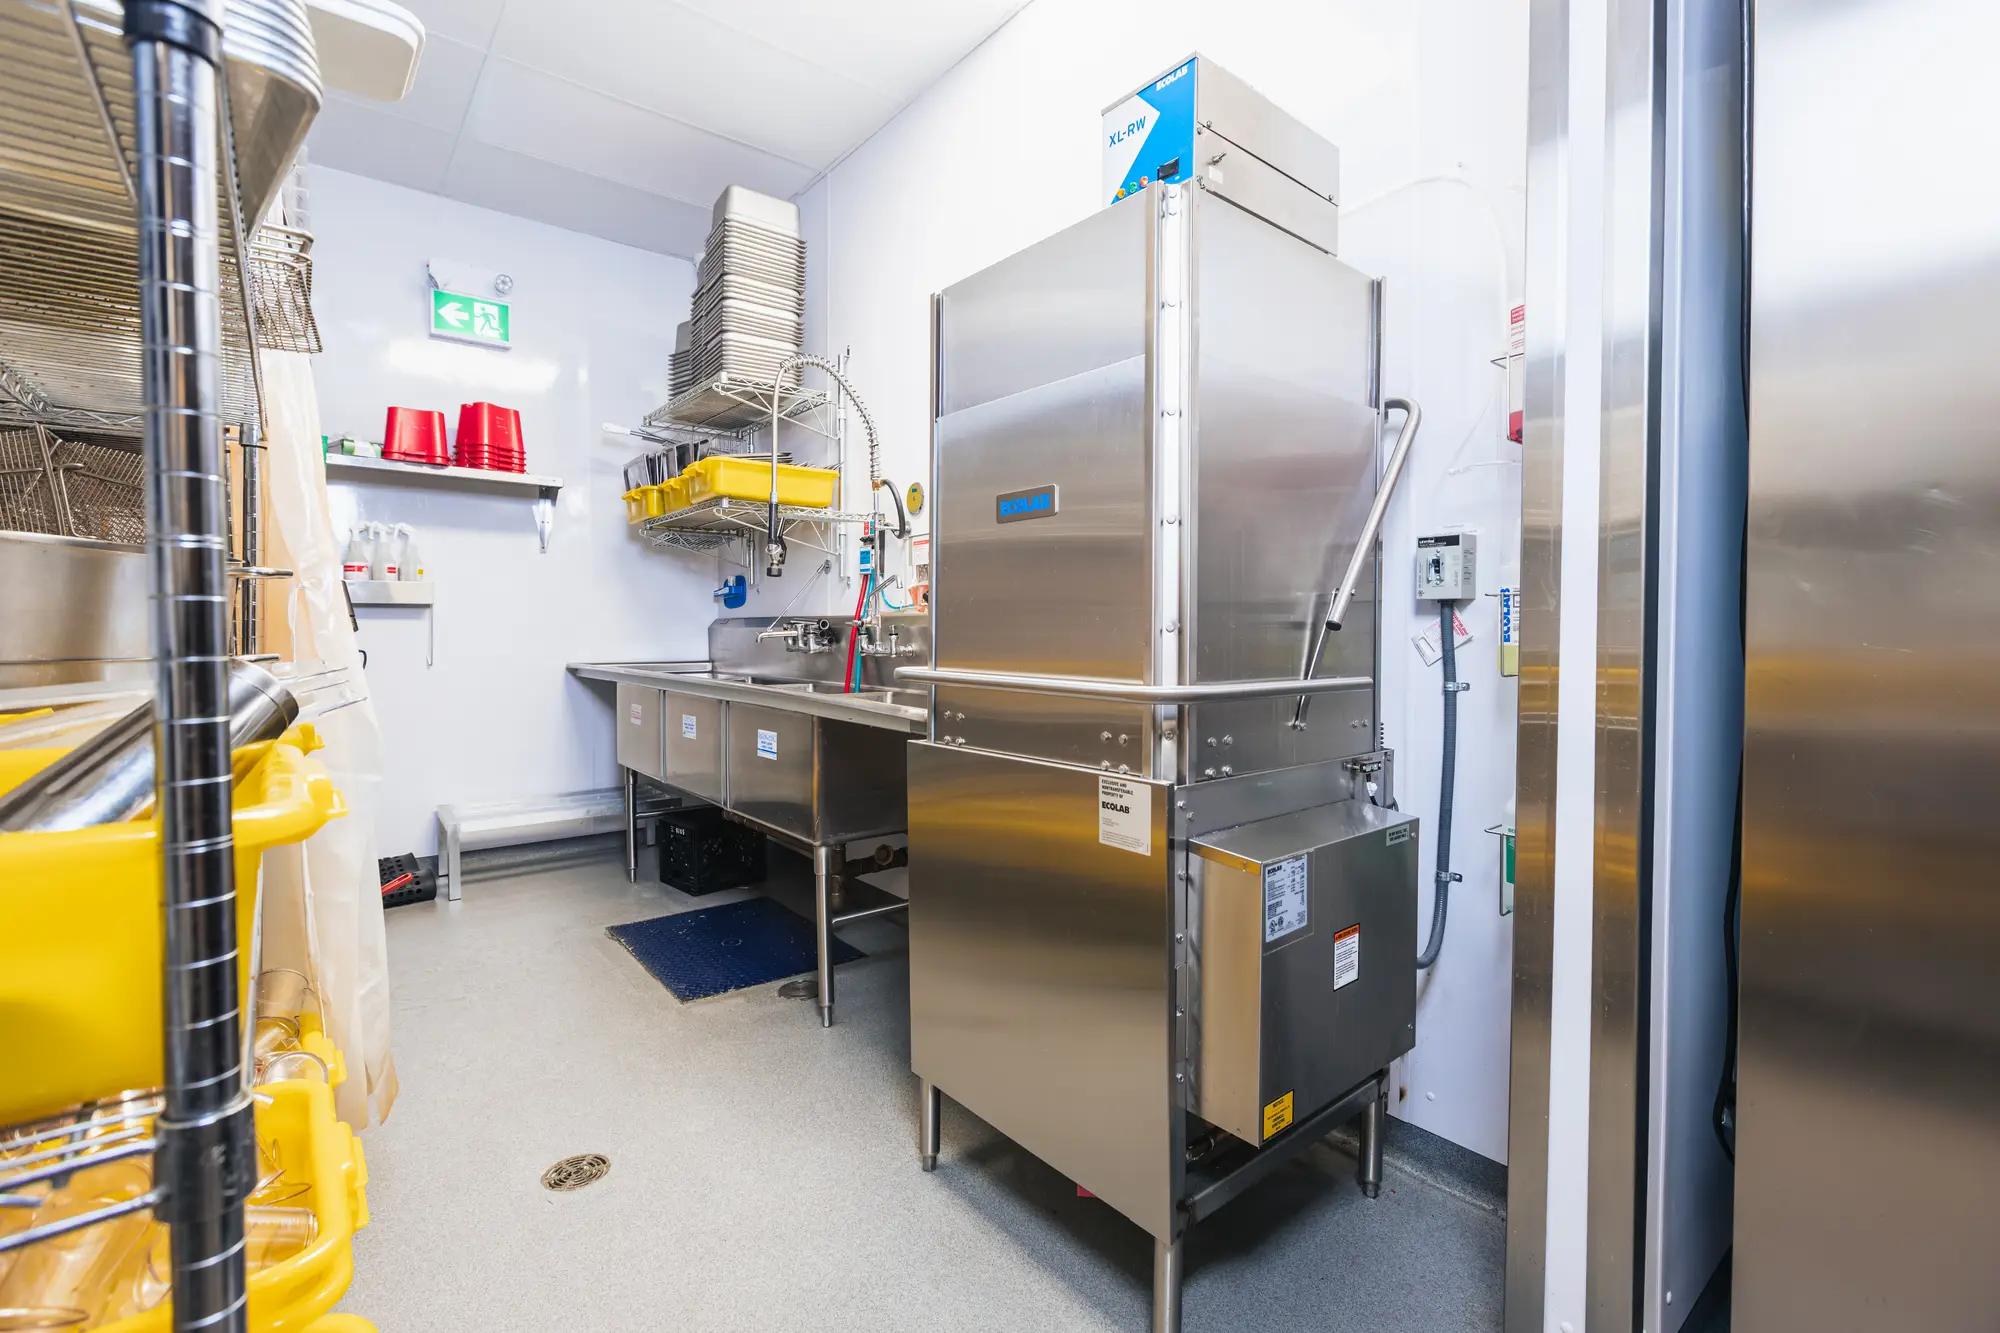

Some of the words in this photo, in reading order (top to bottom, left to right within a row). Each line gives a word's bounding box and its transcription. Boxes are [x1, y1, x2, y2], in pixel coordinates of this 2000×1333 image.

[1156, 65, 1188, 91] ECOLAB
[1109, 116, 1146, 148] XL-RW
[1000, 493, 1050, 516] ECOLAB
[1500, 588, 1510, 642] ECOLAB
[1102, 785, 1133, 795] NONTRANSFERABLE
[1102, 790, 1119, 798] PROPERTY
[1102, 801, 1130, 814] ECOLAB
[1267, 865, 1283, 875] ECOLAB
